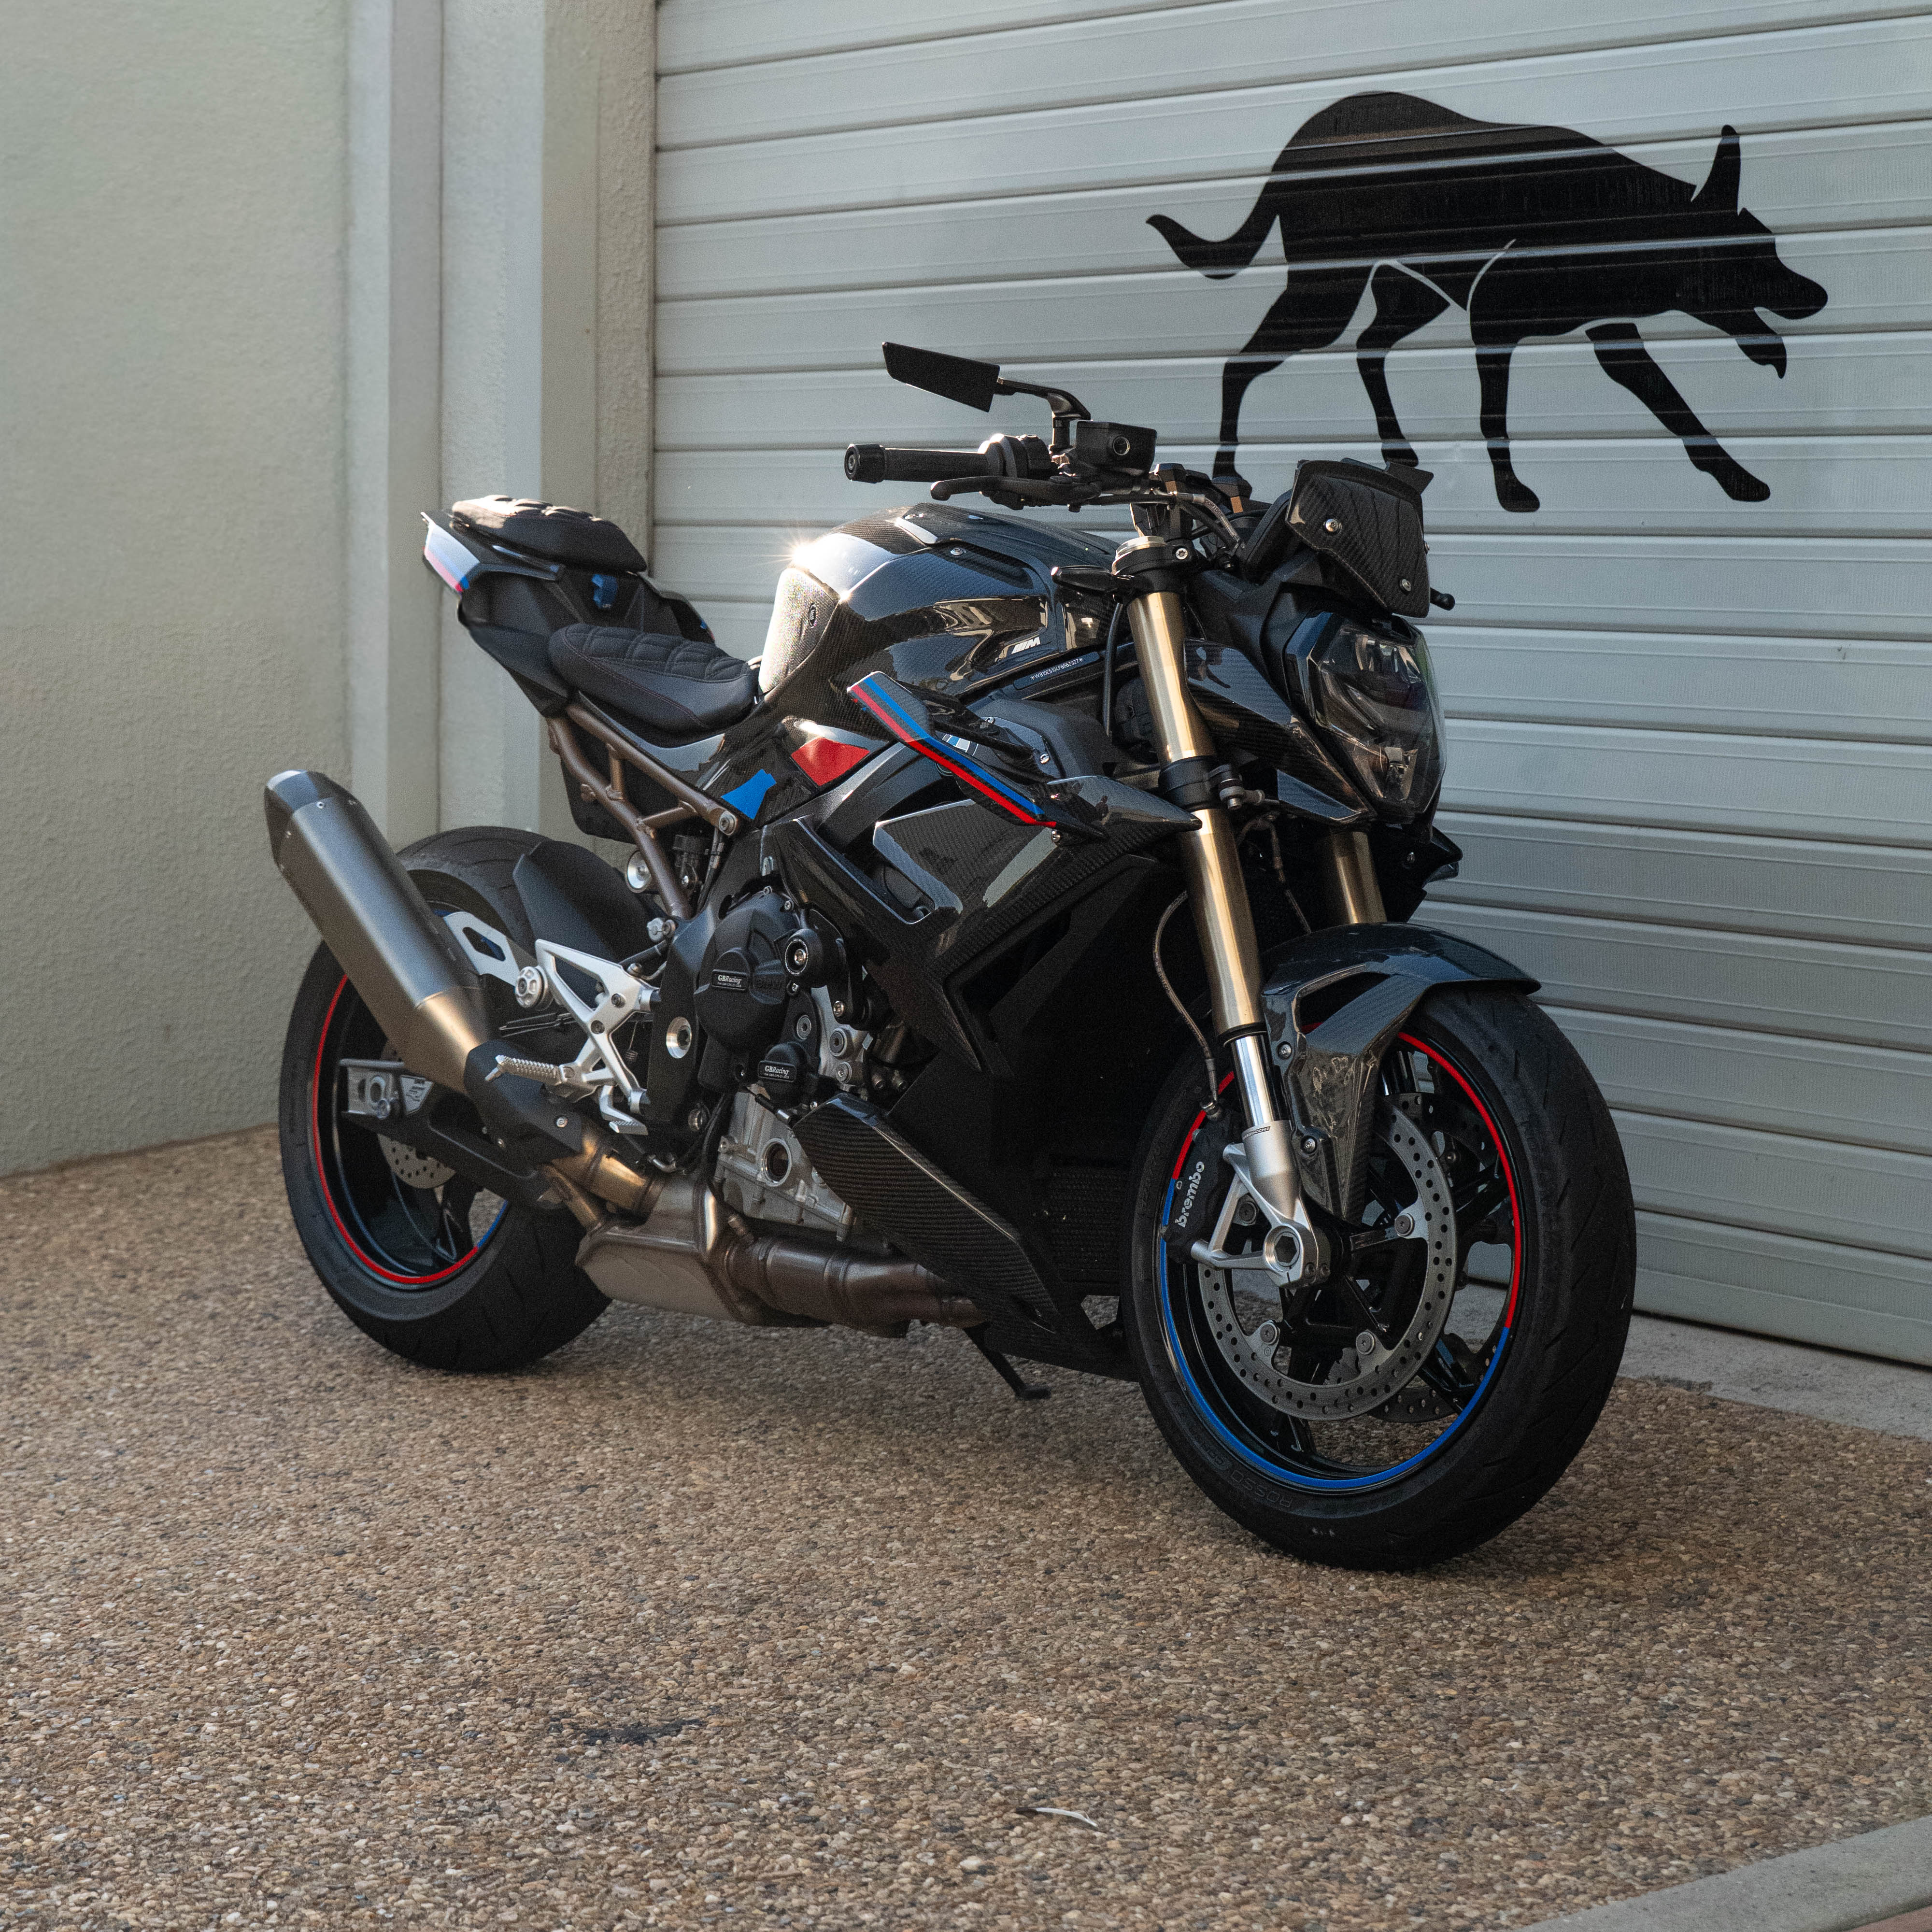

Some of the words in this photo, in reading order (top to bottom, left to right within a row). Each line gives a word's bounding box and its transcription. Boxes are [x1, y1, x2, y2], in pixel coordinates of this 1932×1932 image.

[718, 975, 742, 984] GBRacing
[765, 1065, 790, 1076] GBRacing
[1175, 1161, 1205, 1227] brembo
